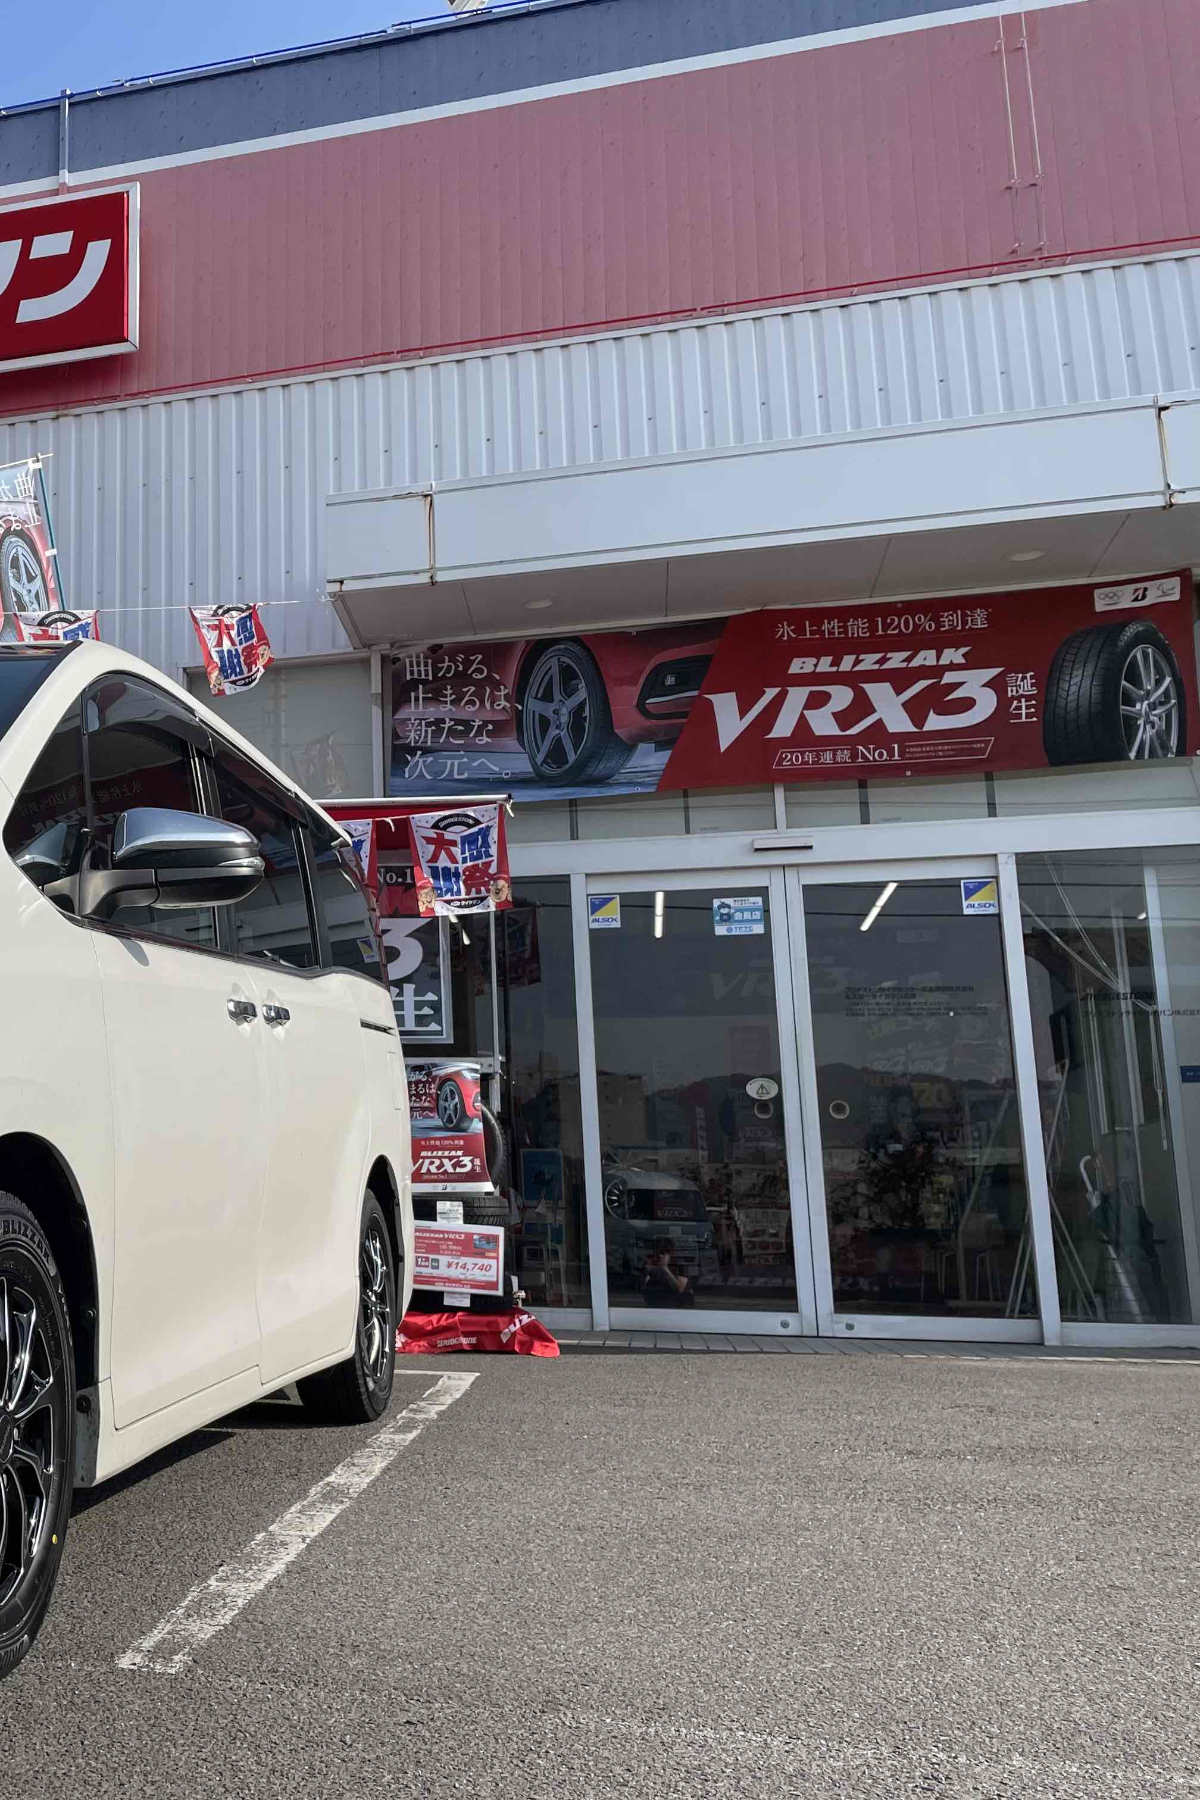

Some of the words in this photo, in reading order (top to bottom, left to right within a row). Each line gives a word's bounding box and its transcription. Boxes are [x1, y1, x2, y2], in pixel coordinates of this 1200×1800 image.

[405, 652, 500, 681] 曲がる、
[787, 647, 972, 674] BLIZZAK
[405, 684, 522, 712] 止まるは、
[702, 667, 1005, 753] VRX3
[1006, 671, 1038, 723] 誕生
[405, 717, 493, 746] 新たな
[405, 751, 511, 780] 次元へ。
[856, 743, 901, 762] No.1
[420, 825, 494, 864] 大感
[733, 911, 761, 920] 会員店
[2, 1219, 52, 1259] BLIZZAK
[447, 1261, 492, 1272] ¥14,740
